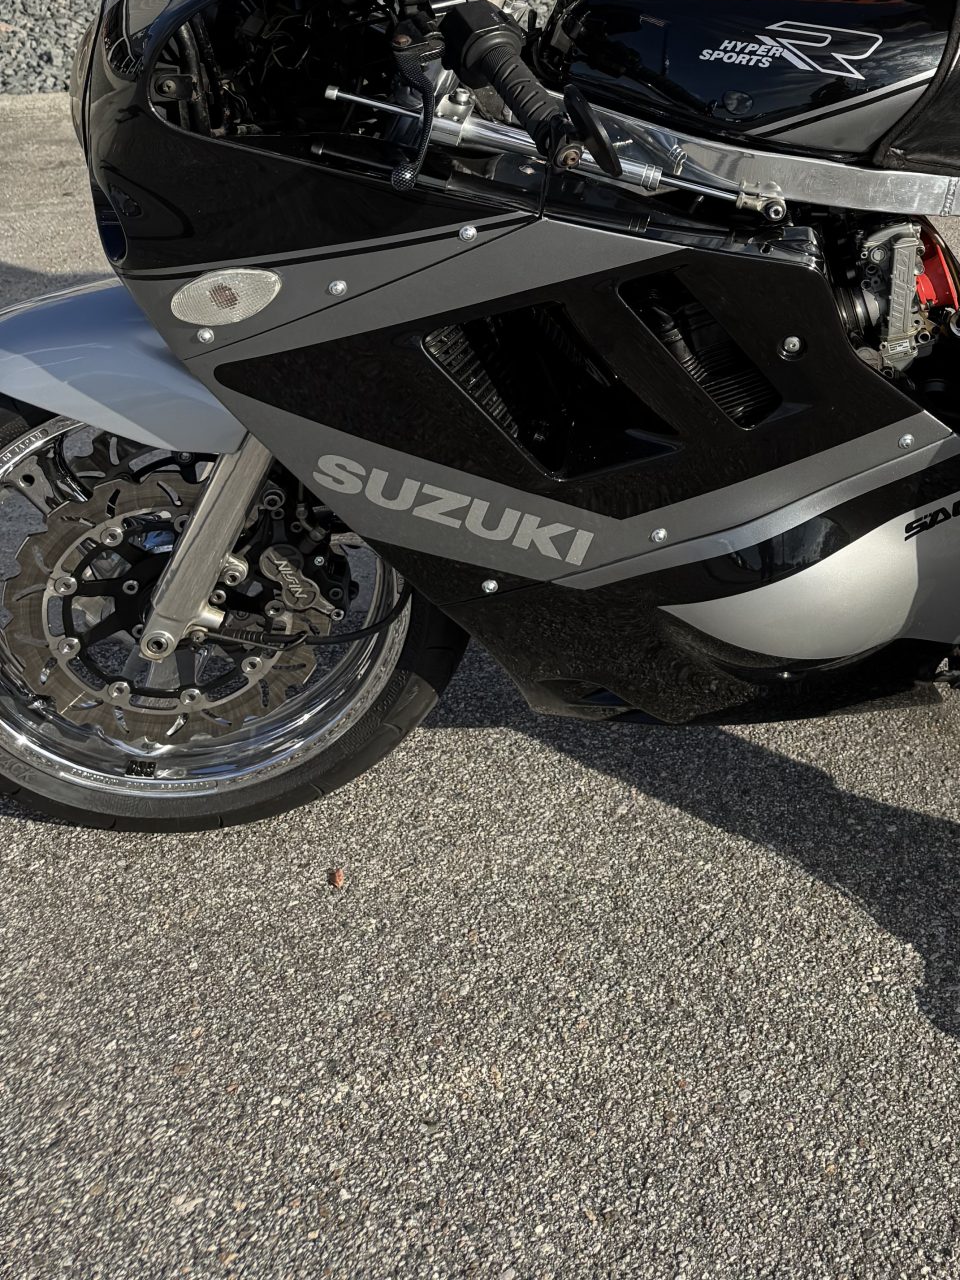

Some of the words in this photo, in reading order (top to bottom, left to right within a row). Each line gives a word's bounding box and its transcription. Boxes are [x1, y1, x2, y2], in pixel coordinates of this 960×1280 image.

[718, 39, 784, 58] HYPER
[699, 49, 773, 69] SPORTS
[312, 454, 595, 566] SUZUKI
